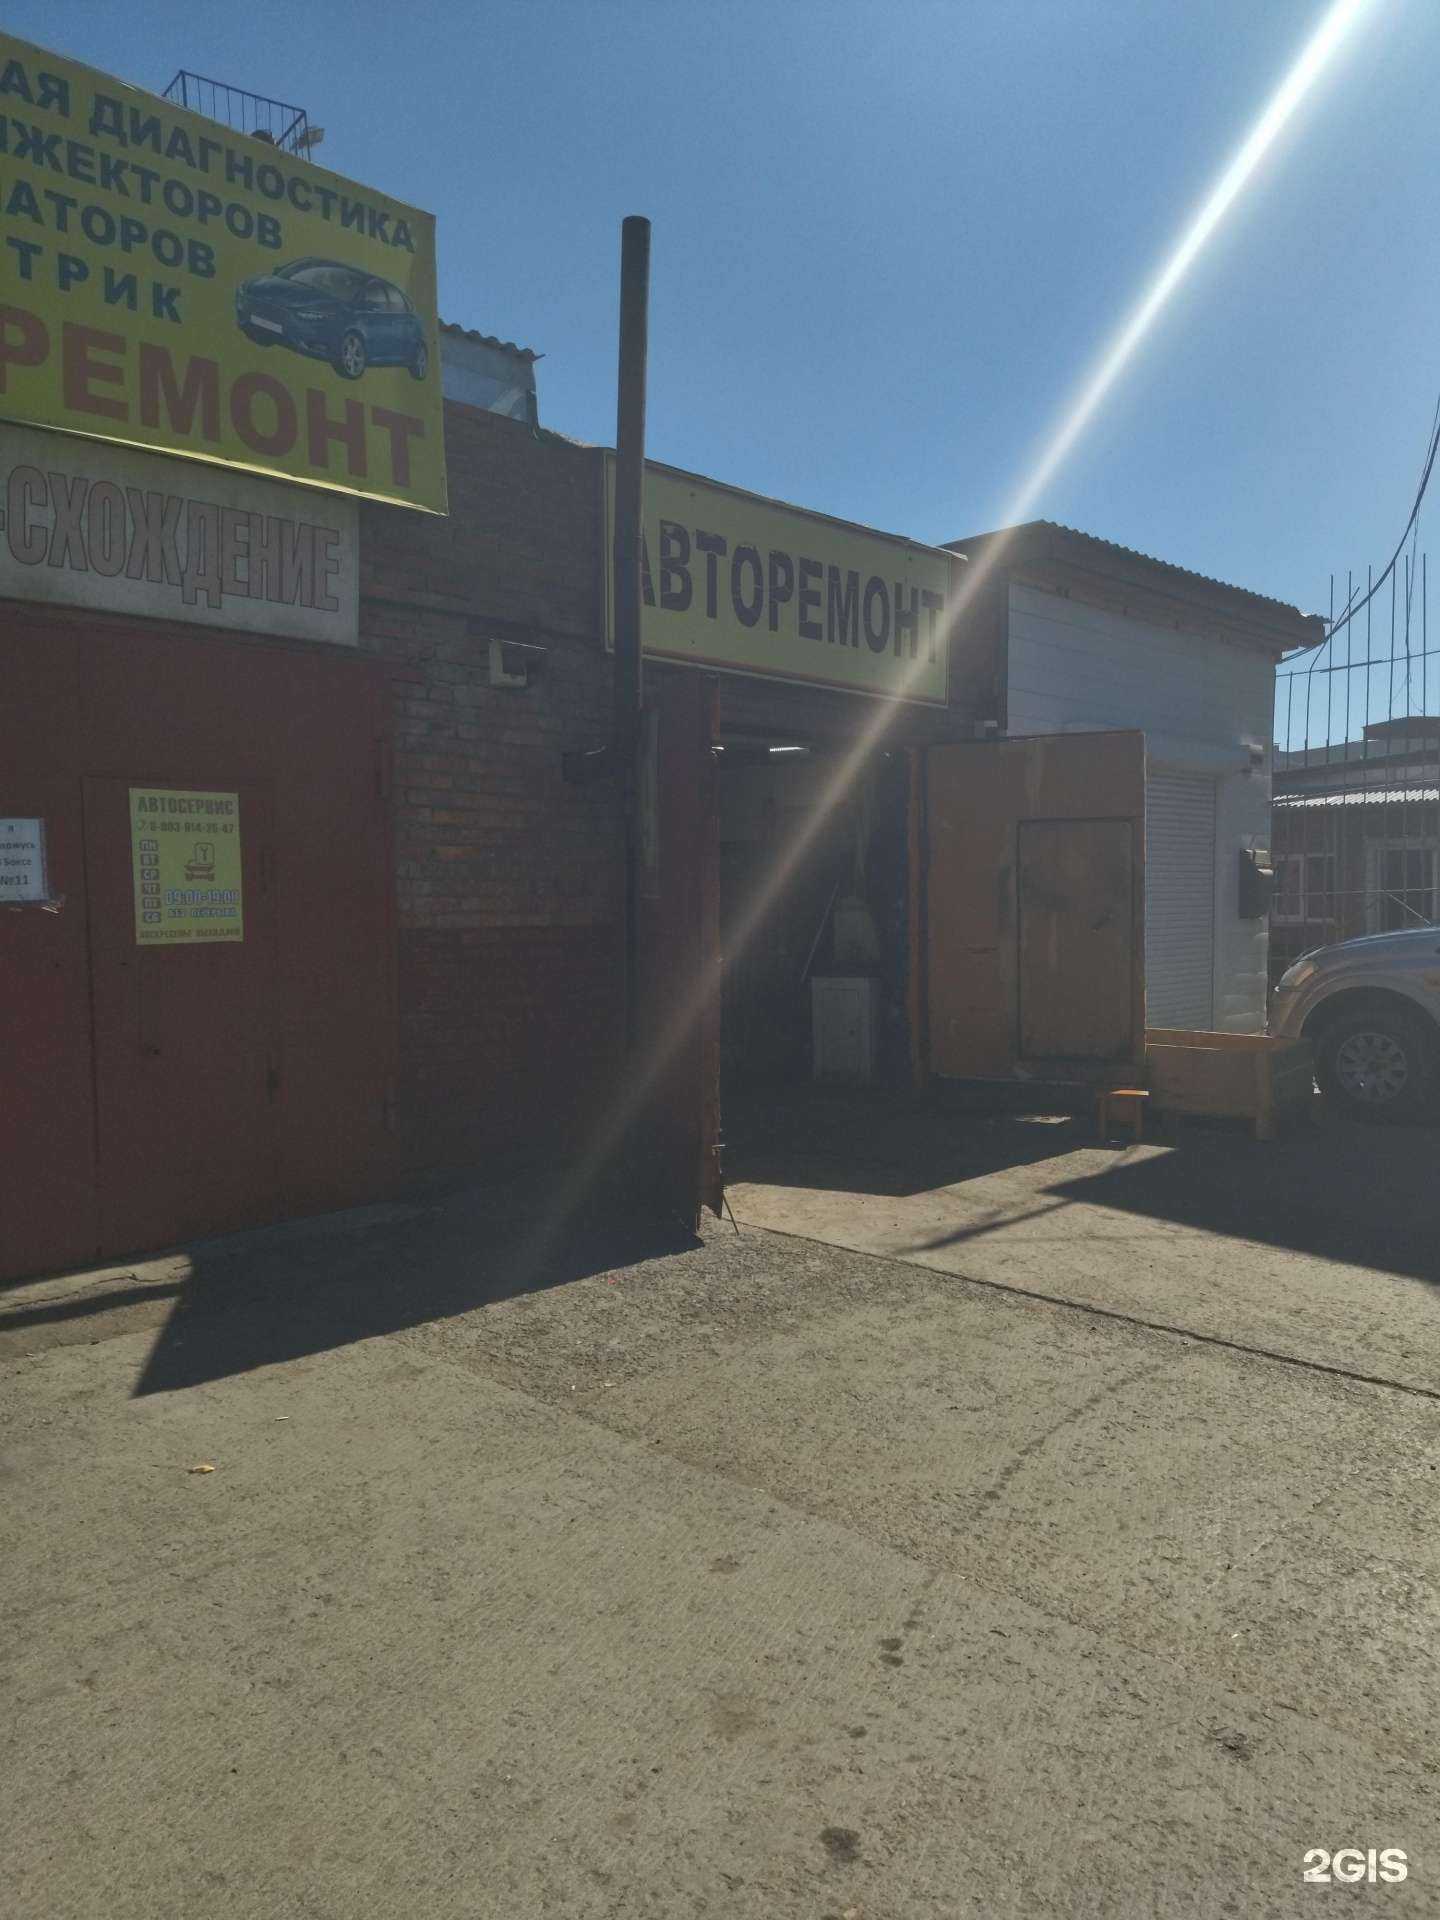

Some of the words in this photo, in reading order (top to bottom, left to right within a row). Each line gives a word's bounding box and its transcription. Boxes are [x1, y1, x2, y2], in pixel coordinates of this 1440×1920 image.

[0, 59, 70, 118] АЯ
[90, 93, 416, 254] ДИАГНОСТИКА
[4, 179, 217, 279] АТОРОВ
[0, 303, 426, 489] РЕМОНТ
[138, 796, 233, 815] АВТОСЕРВИС
